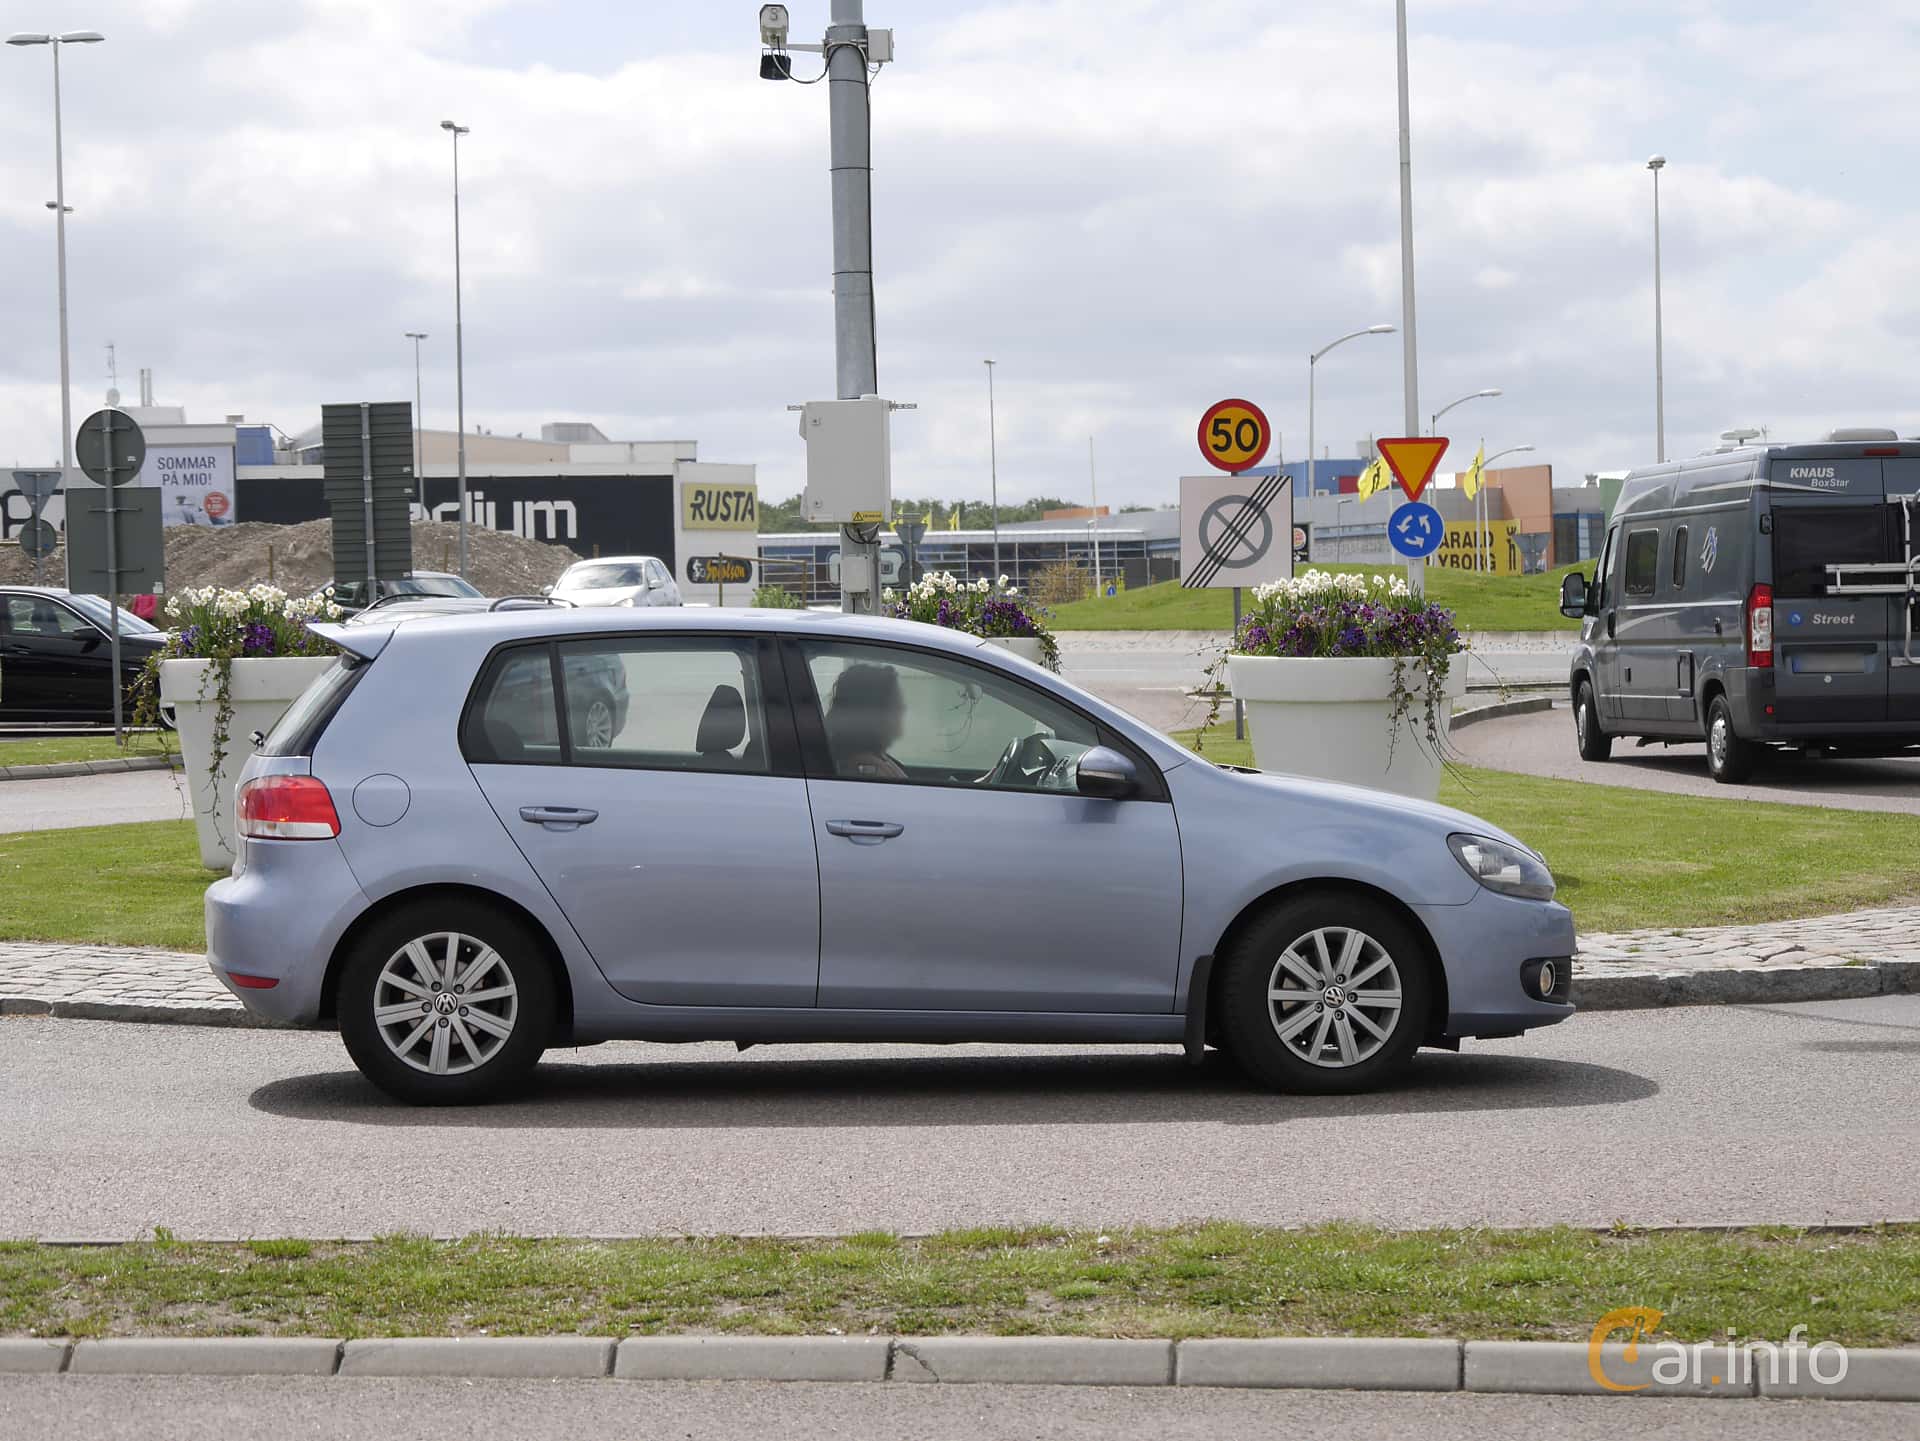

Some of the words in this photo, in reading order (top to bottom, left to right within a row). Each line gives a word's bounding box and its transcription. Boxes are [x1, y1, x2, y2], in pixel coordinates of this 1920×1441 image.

[1212, 418, 1259, 452] 50
[158, 456, 216, 470] SOMMAR
[162, 471, 179, 486] PÅ
[183, 472, 212, 486] MIO!
[1790, 467, 1835, 479] KNAUS
[1811, 478, 1850, 488] BoxStar
[690, 490, 755, 522] RUSTA
[1426, 553, 1497, 572] YBORG
[1812, 613, 1856, 625] Street
